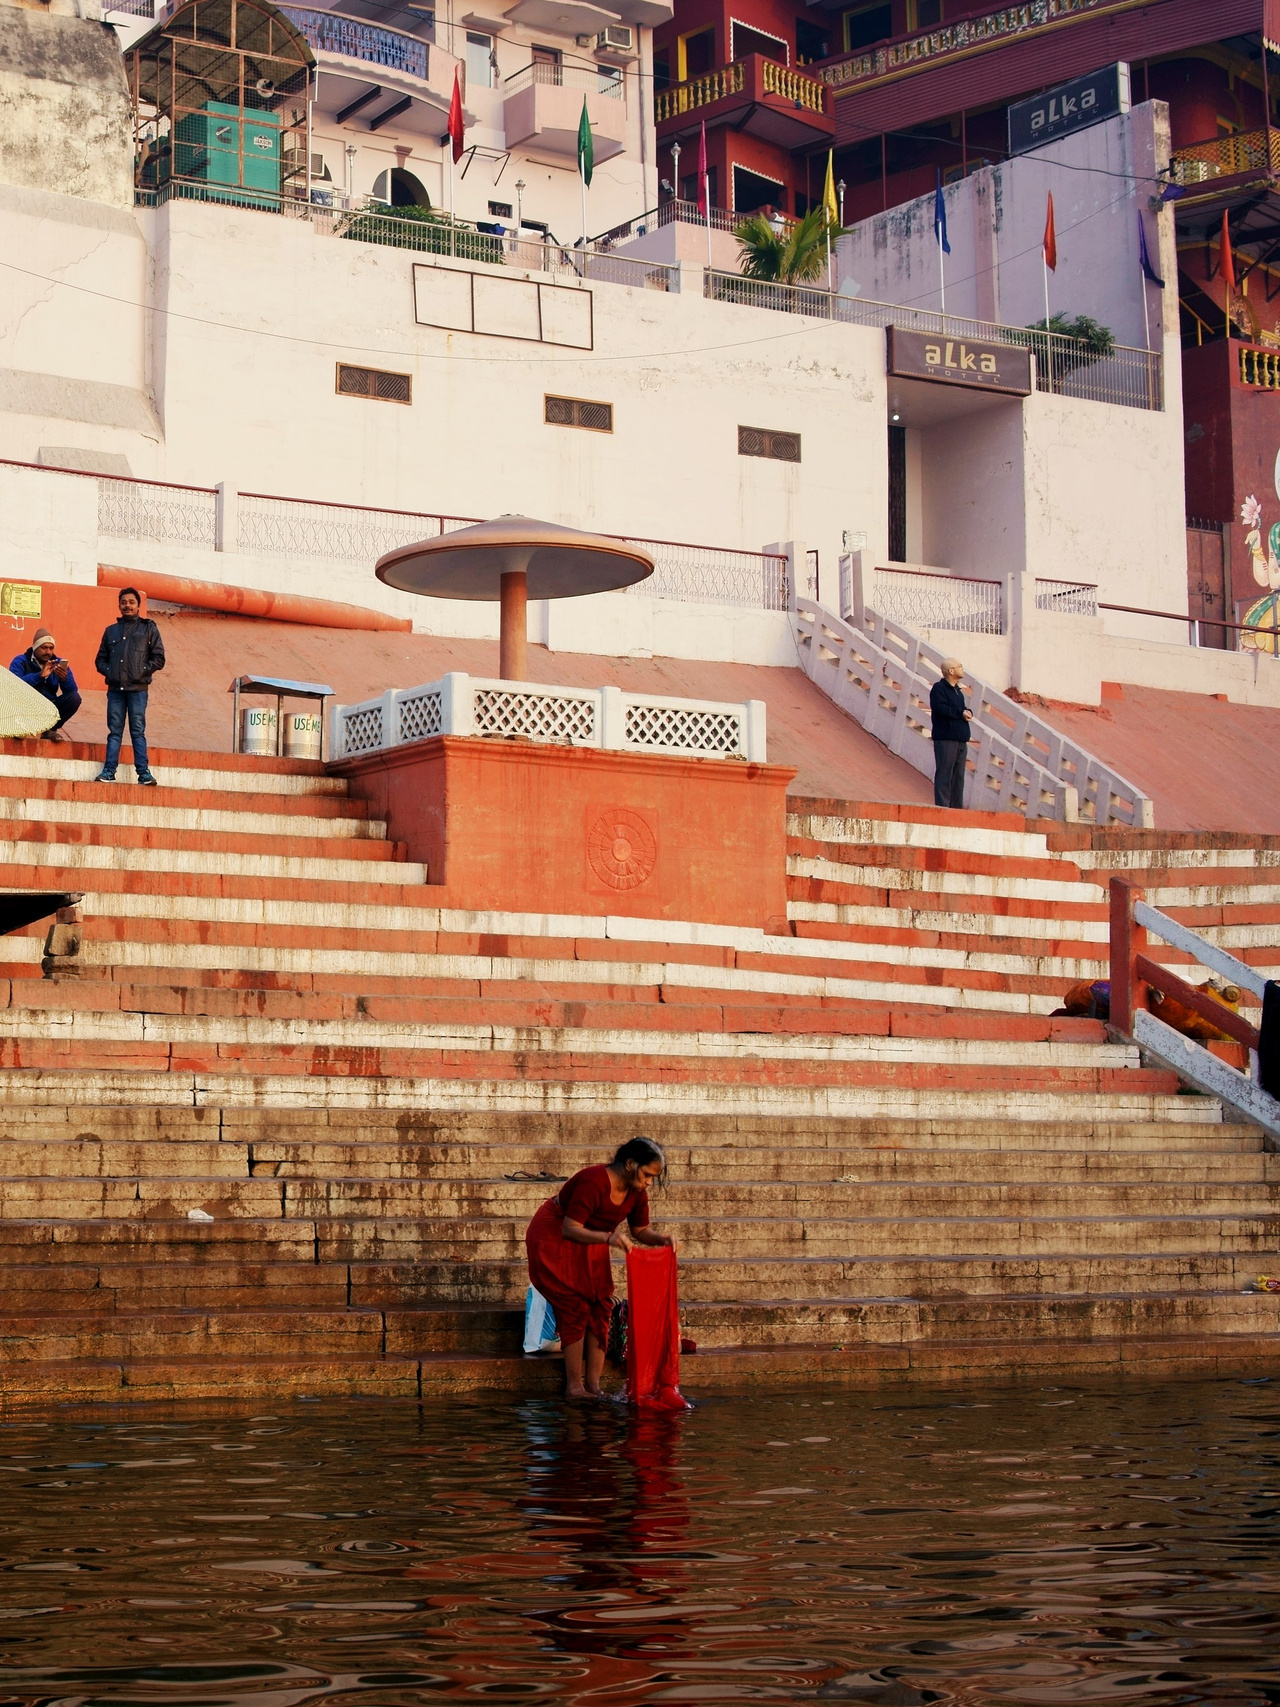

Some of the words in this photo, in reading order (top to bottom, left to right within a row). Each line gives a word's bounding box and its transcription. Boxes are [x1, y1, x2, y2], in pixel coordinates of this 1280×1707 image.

[1032, 108, 1098, 138] HOTEL
[928, 367, 999, 383] HOTEL
[250, 713, 267, 726] USE
[294, 717, 311, 731] USE
